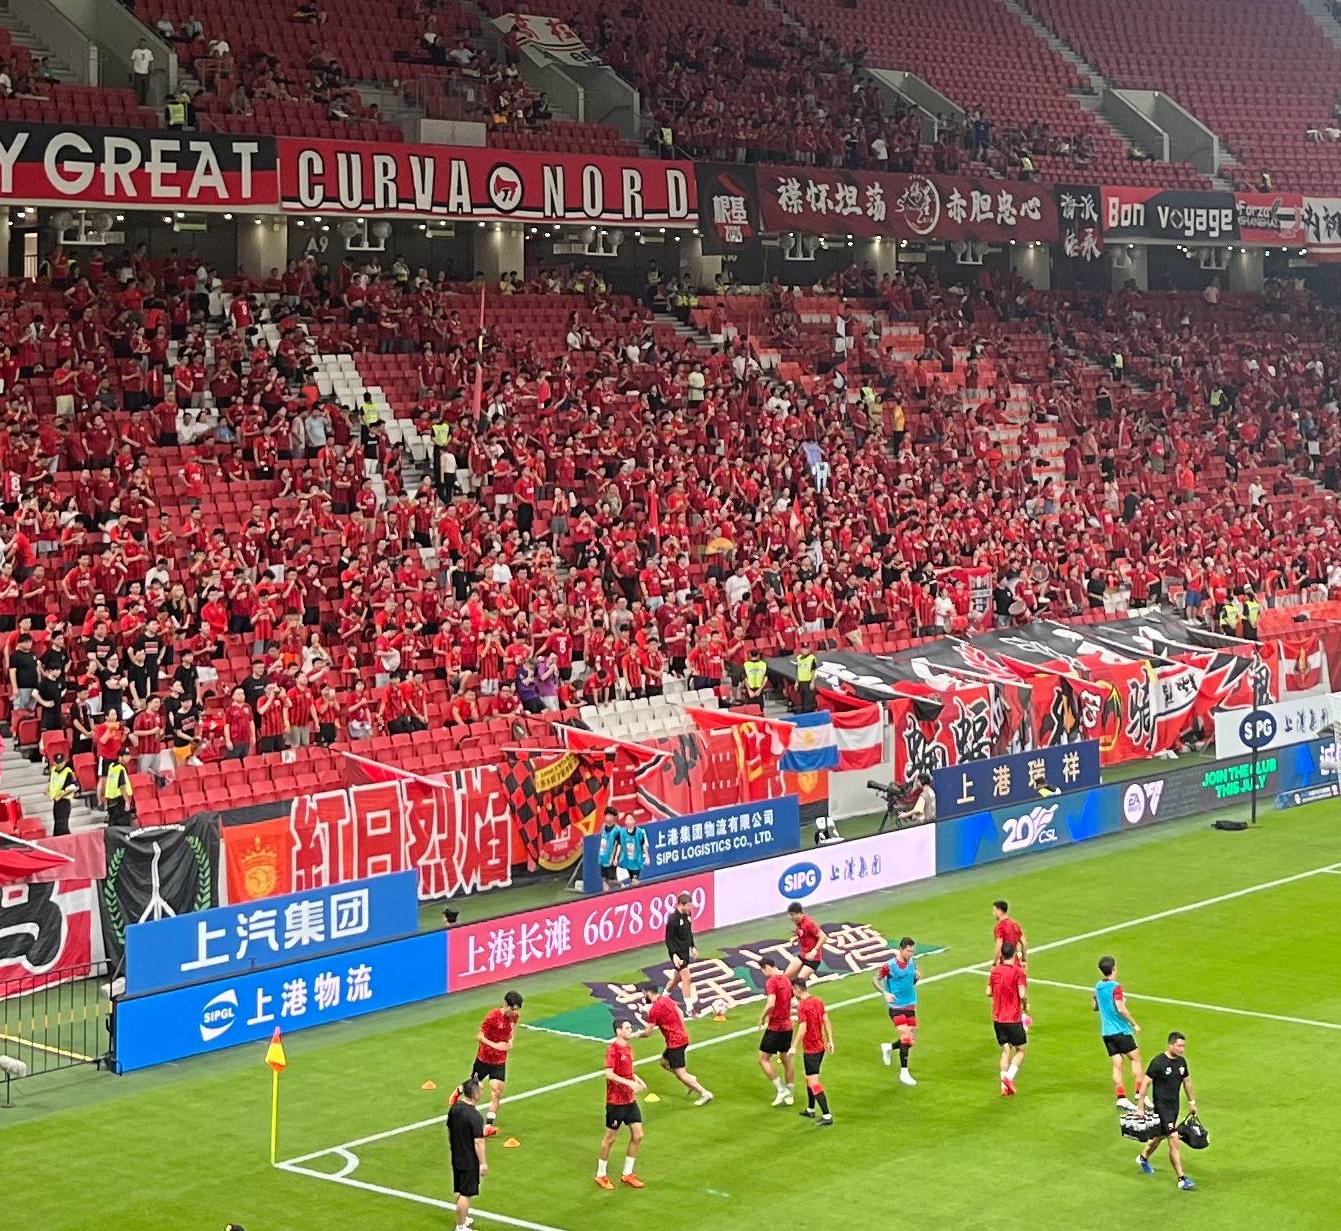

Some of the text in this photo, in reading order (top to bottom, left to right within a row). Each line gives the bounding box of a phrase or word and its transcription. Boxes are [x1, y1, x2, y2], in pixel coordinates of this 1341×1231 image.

[46, 134, 256, 201] GREAT
[299, 149, 690, 218] CURVA NORD
[946, 187, 1042, 226] 赤胆忠心
[1107, 197, 1234, 238] Bon Voyage
[307, 235, 329, 253] A9
[1244, 718, 1273, 741] SPG
[956, 751, 1081, 805] 上港瑞祥
[1202, 770, 1228, 788] JOIN
[1238, 776, 1267, 795] JUY
[655, 809, 775, 849] 上港集团物流有限公司
[1002, 813, 1036, 853] 20
[1038, 827, 1058, 844] CSL
[655, 847, 679, 866] SIPG
[681, 838, 732, 861] LOGISTICS
[783, 870, 817, 893] SIPG
[180, 887, 370, 972] 上汽集团
[459, 914, 572, 978] 上海长滩
[583, 900, 644, 946] 6678
[247, 963, 373, 1026] 上港物流
[203, 1007, 235, 1024] SIPGL
